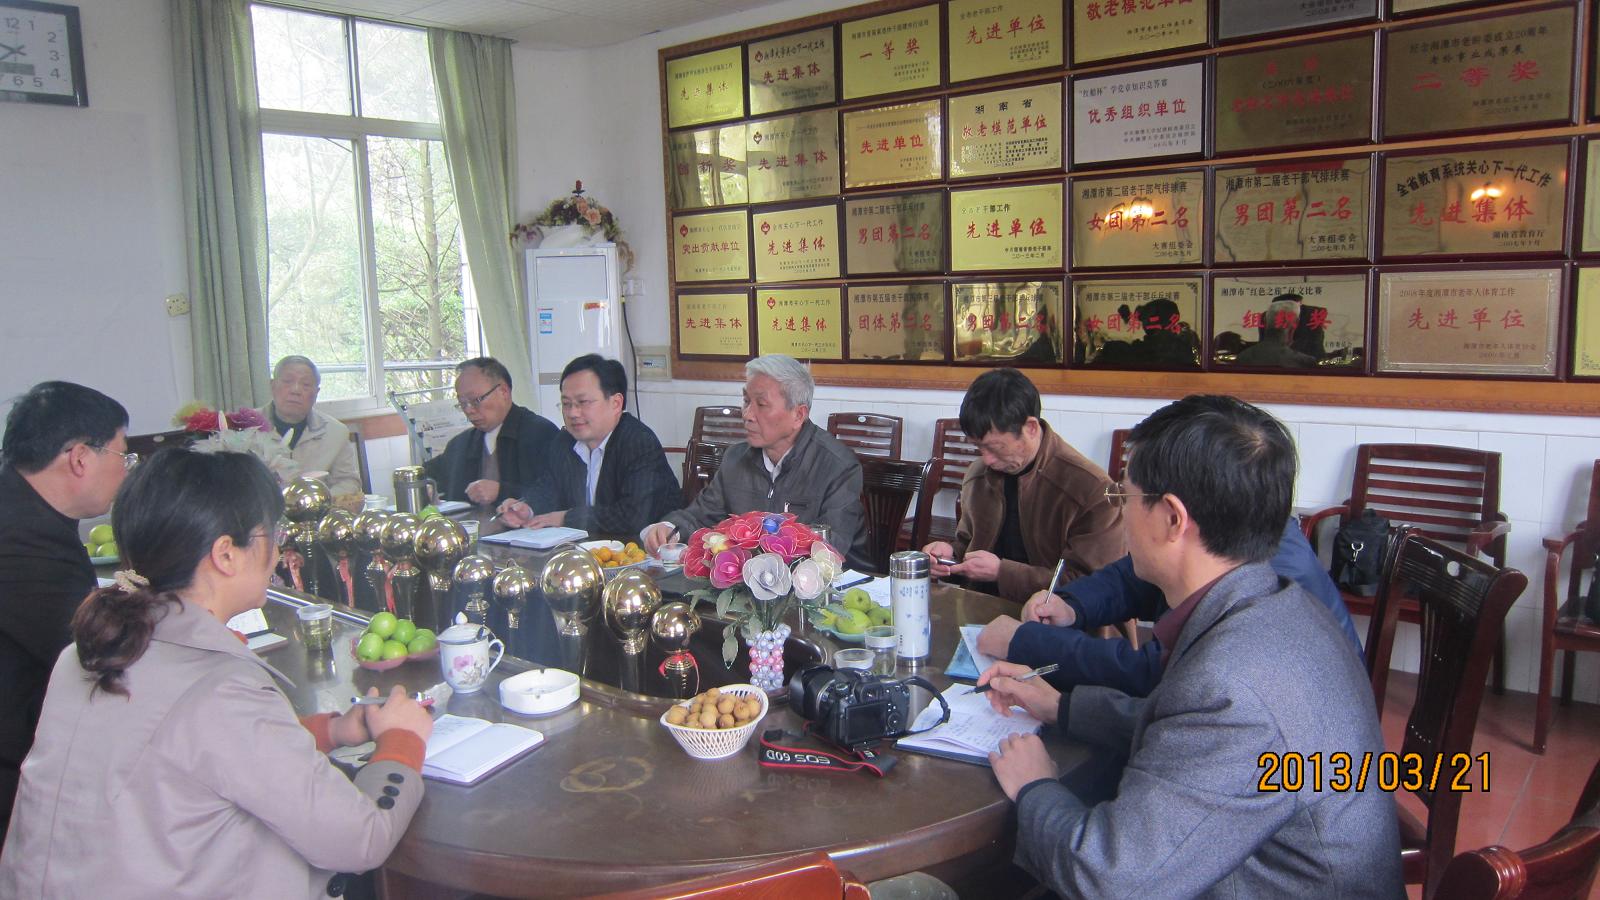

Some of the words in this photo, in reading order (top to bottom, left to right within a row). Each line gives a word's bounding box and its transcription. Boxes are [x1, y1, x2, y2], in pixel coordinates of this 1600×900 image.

[1086, 0, 1193, 21] 敬老模范
[6, 17, 20, 29] 12
[28, 20, 35, 31] 1
[967, 14, 1047, 45] 先进单位
[47, 31, 57, 43] 2
[49, 50, 60, 61] 3
[859, 37, 921, 61] 一等奖
[13, 75, 24, 86] 6
[33, 77, 43, 87] 5
[50, 68, 61, 79] 4
[763, 62, 821, 85] 先进集体
[1412, 60, 1541, 92] 二等奖
[975, 98, 1033, 115] 湖南省
[1088, 98, 1187, 124] 优秀组织单位
[961, 115, 1048, 139] 敬老模范单位
[859, 134, 924, 154] 先进单位
[758, 149, 828, 171] 先进集体
[1226, 168, 1350, 191] 湘潭市第二届老干部气排球赛
[1397, 159, 1552, 197] 全省教育系统关心下一代工作
[1082, 181, 1188, 199] 湘潭市第二届老干部气排球赛
[1086, 206, 1189, 233] 女团第二名
[1234, 196, 1353, 226] 男团第二名
[1410, 195, 1534, 228] 先进集体
[857, 223, 932, 245] 男团第二名
[966, 217, 1047, 239] 先进单位
[681, 241, 740, 255] 突出贡献单位
[767, 235, 826, 256] 先进集体
[685, 317, 743, 329] 先进集体
[771, 315, 827, 332] 先进集体
[858, 311, 933, 334] 团体第二名
[966, 310, 1047, 333] 男团第二名
[1087, 313, 1182, 334] 女团第二名
[1242, 307, 1333, 331] 组织奖
[1407, 307, 1526, 331] 先进单位
[765, 750, 791, 761] 60D
[794, 754, 831, 765] EOS
